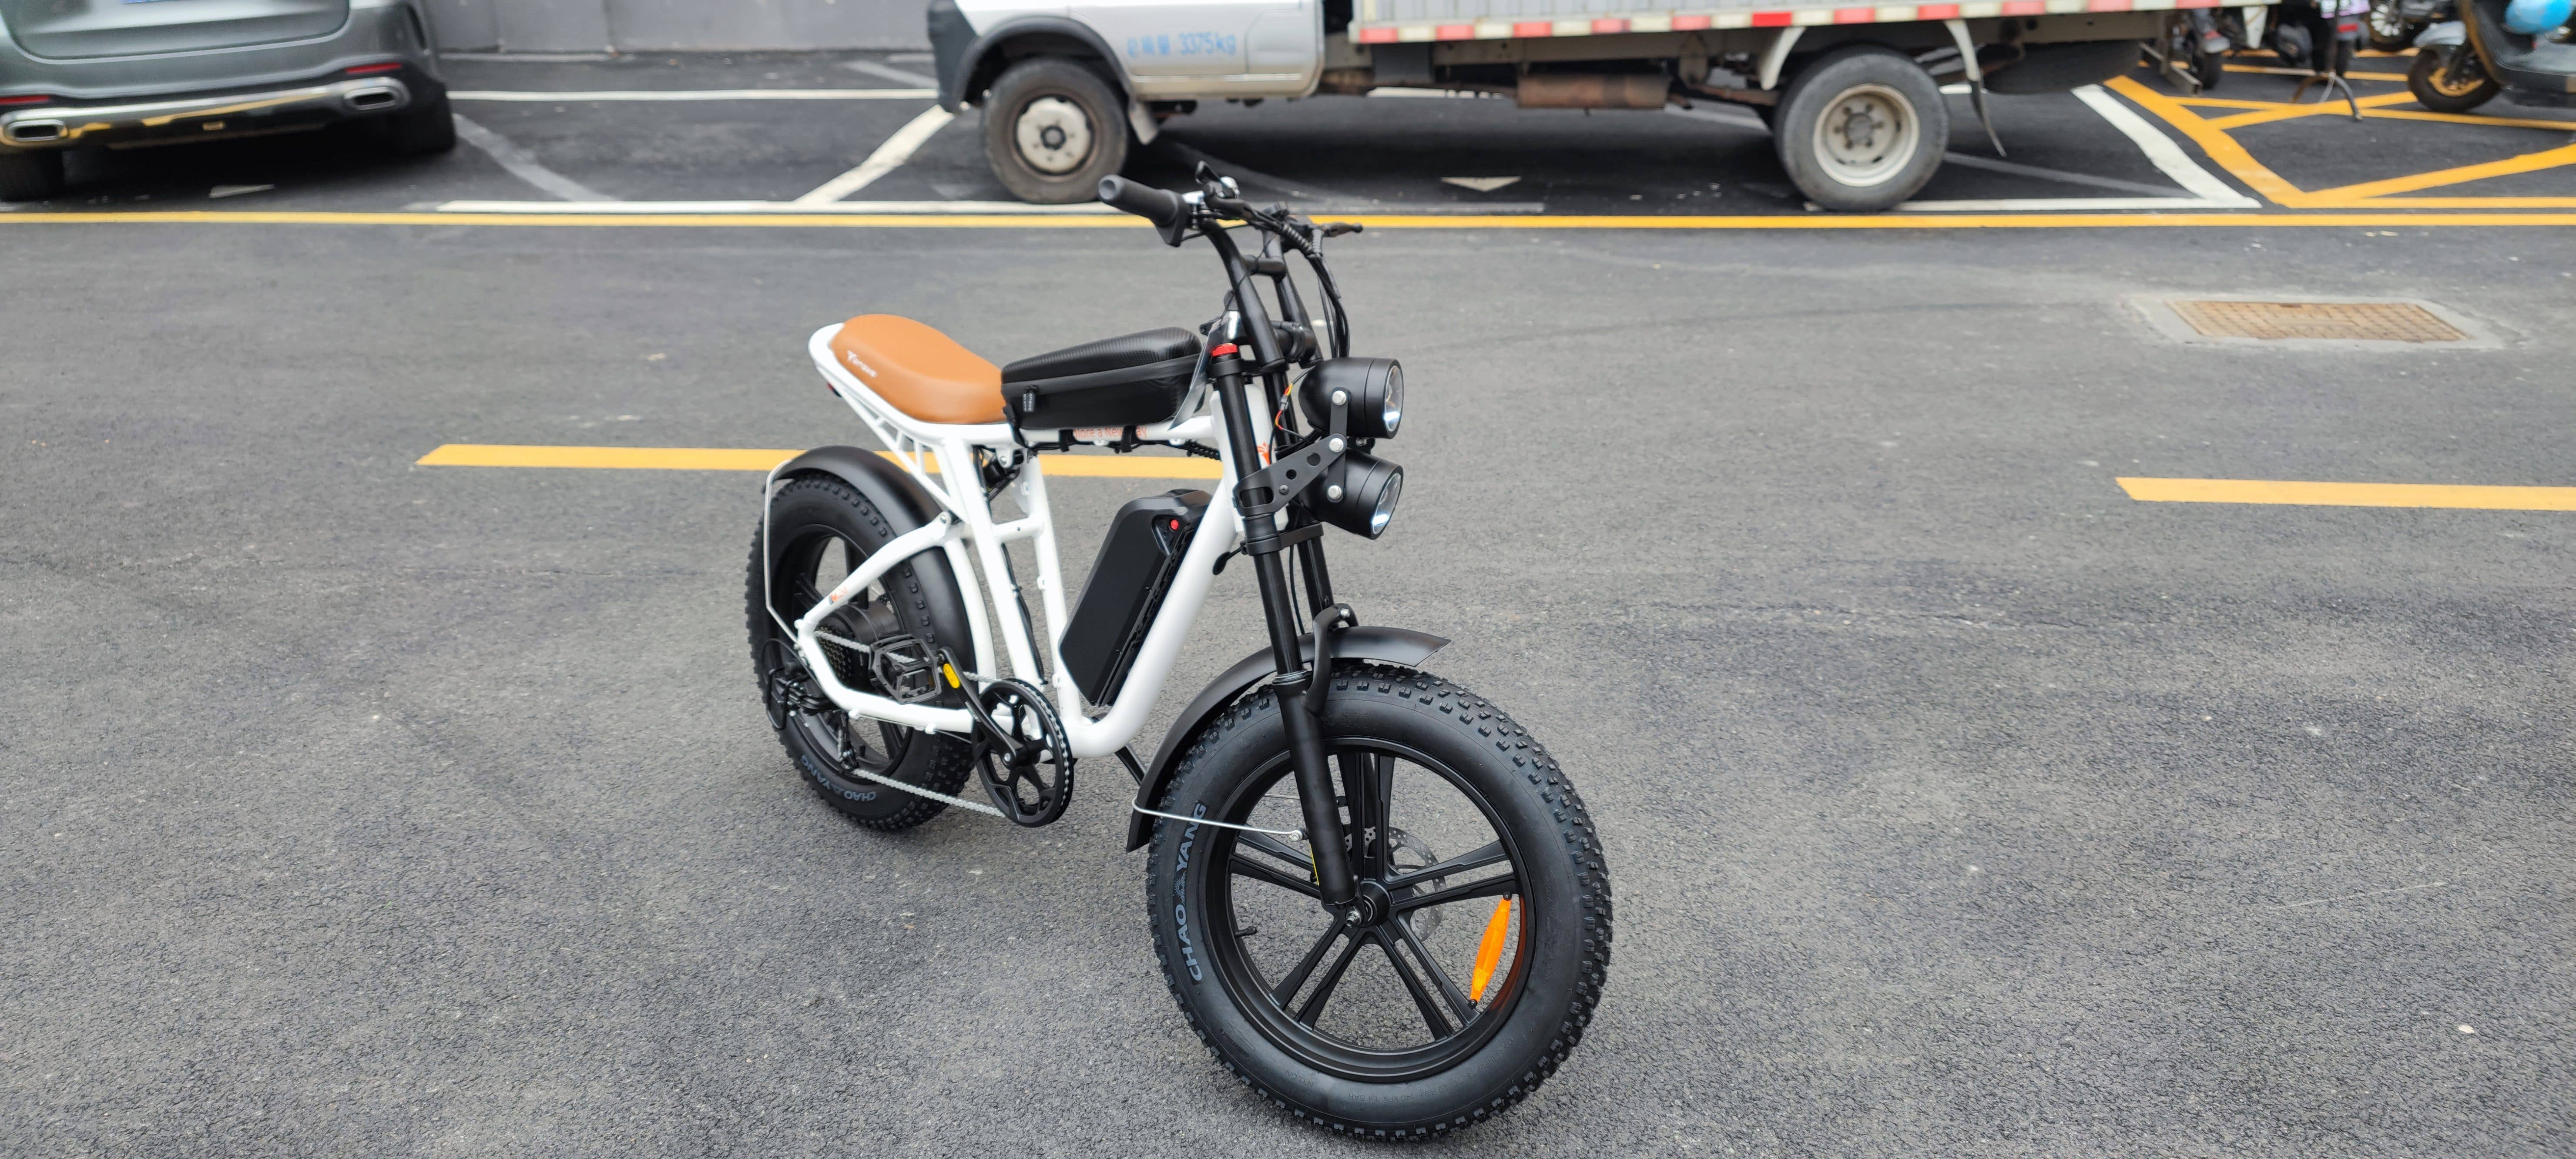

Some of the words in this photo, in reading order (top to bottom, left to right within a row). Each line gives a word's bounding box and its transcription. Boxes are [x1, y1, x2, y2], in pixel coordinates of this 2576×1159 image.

[801, 754, 830, 789] YANG
[844, 790, 875, 801] CHAO
[1176, 803, 1208, 874] YANG
[1175, 904, 1202, 981] CHAO
[1285, 1069, 1314, 1088] NYLON
[1348, 1093, 1365, 1102] BAR
[1401, 1093, 1415, 1102] 140
